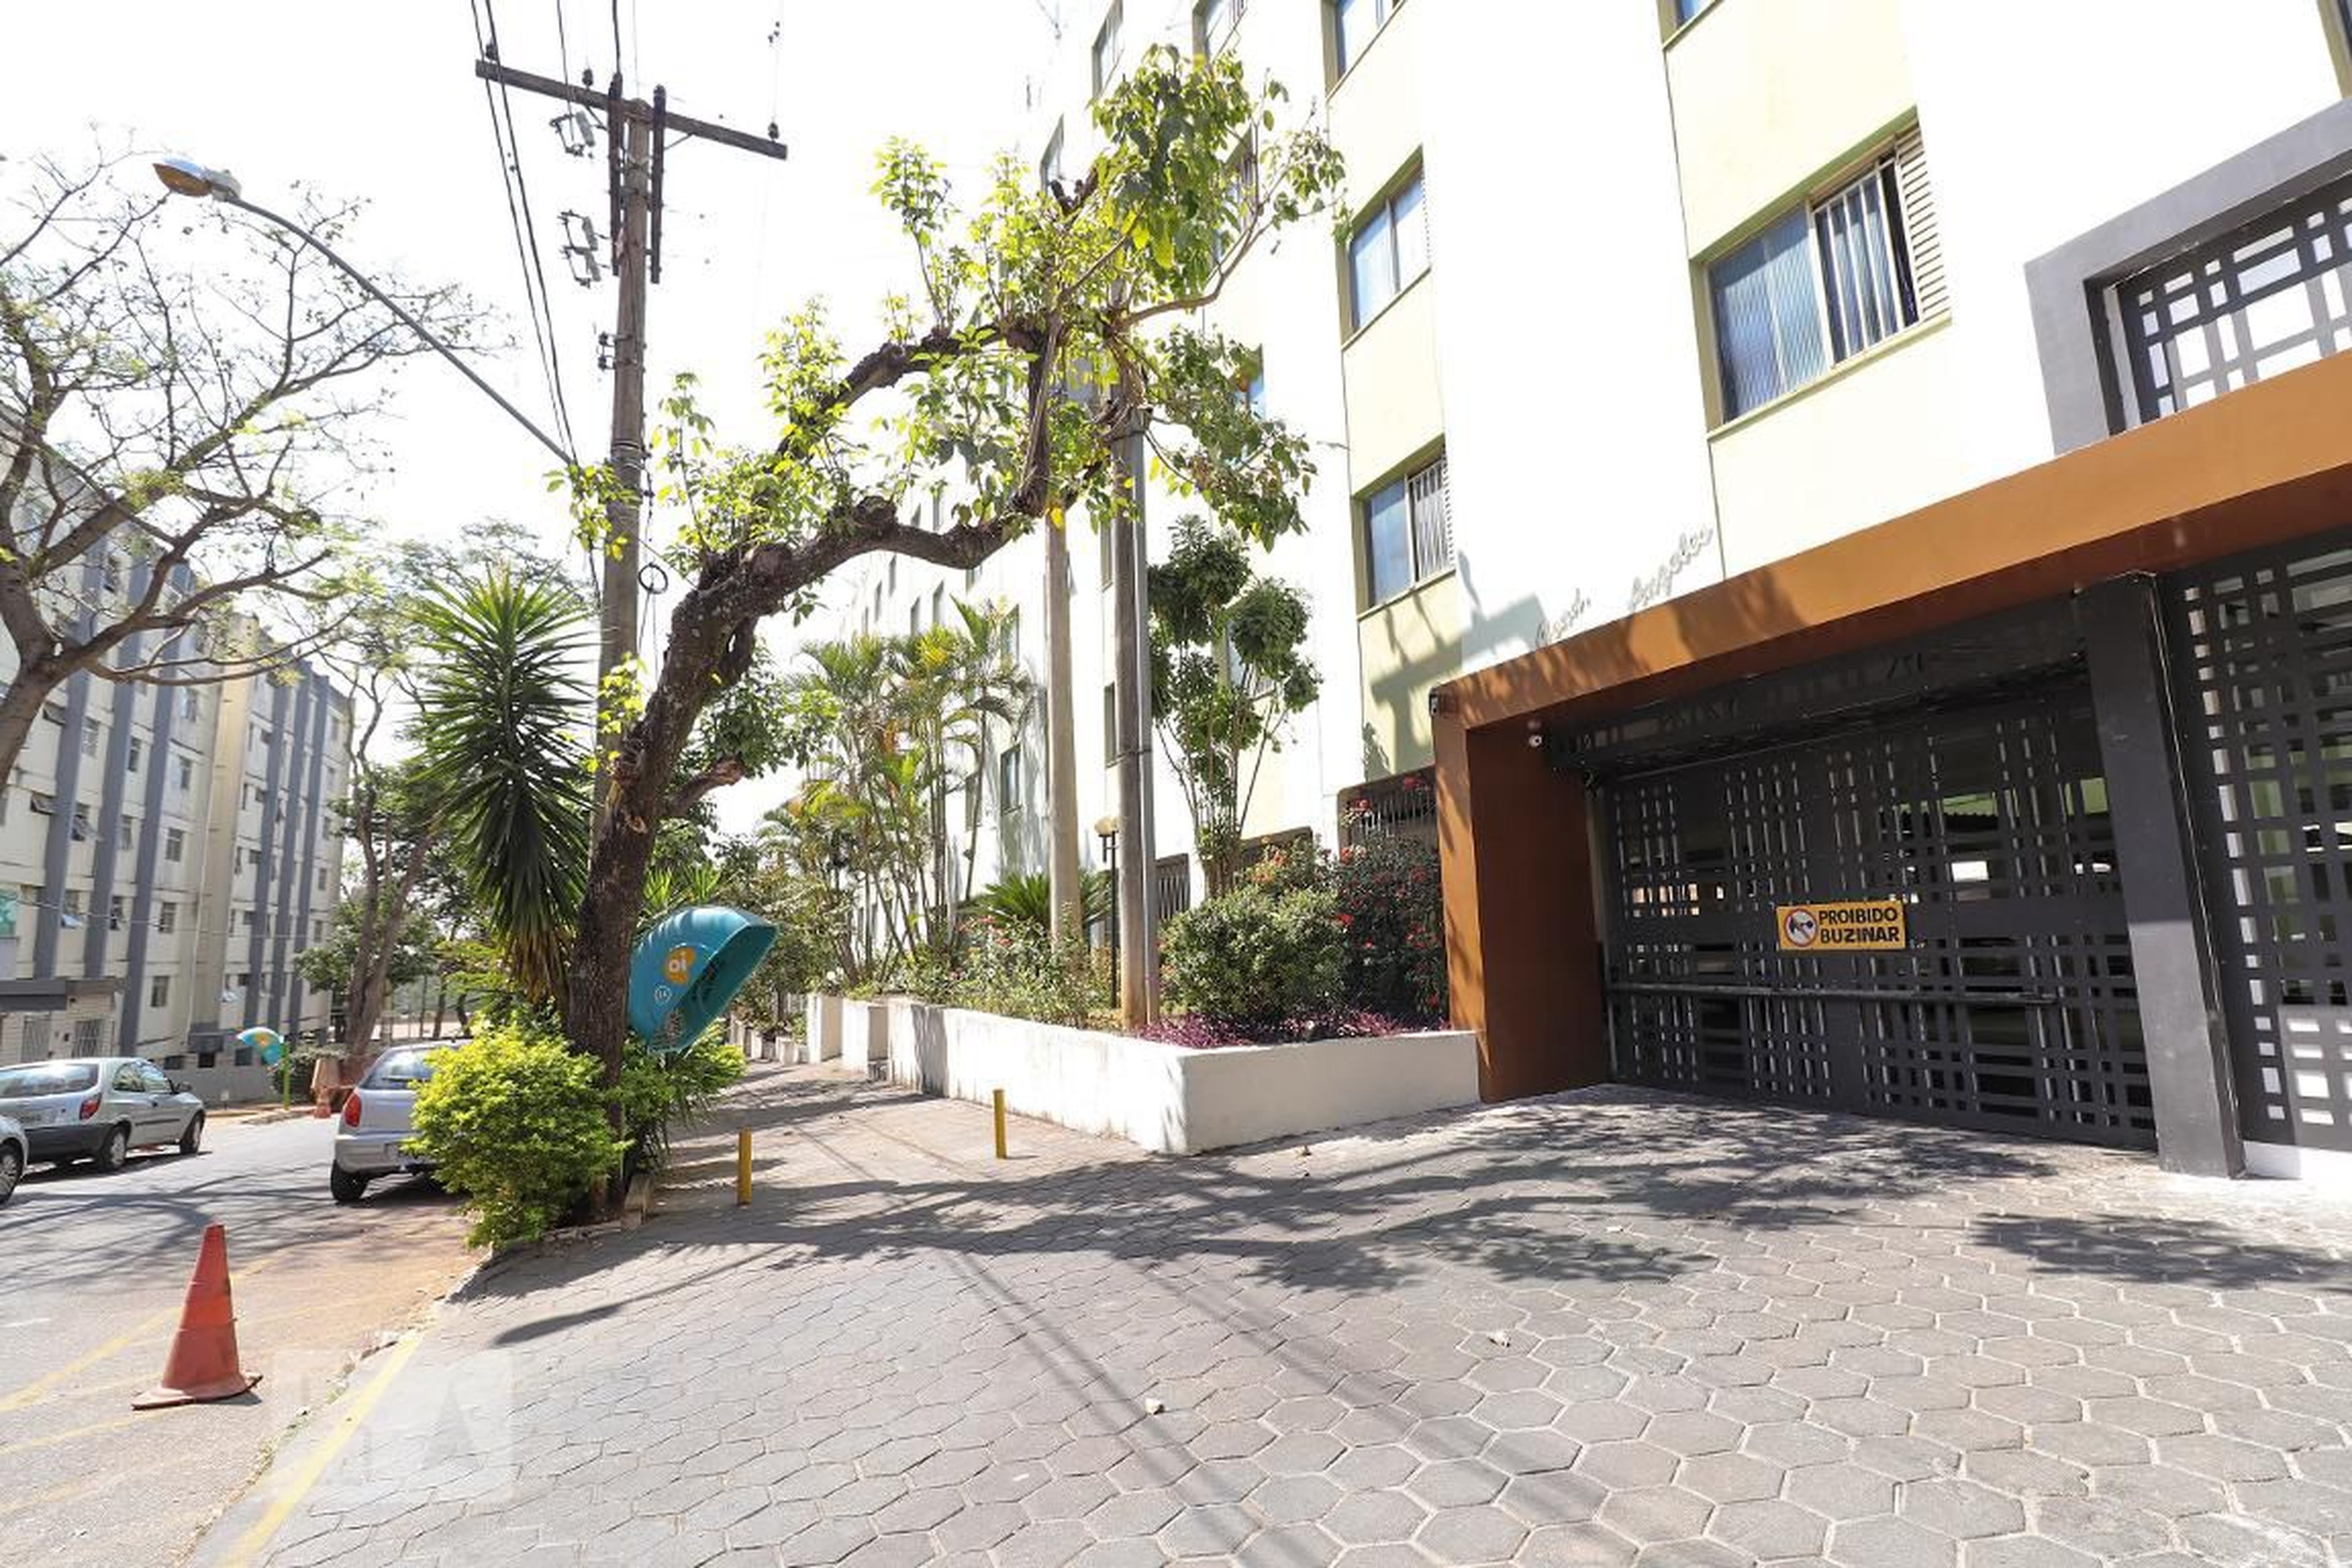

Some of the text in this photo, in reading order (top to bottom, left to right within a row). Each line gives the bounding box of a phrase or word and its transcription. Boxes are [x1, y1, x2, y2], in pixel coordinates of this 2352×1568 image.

[1818, 907, 1898, 925] PROIBIDO
[1820, 926, 1900, 944] BUZINAR
[668, 951, 687, 973] oi
